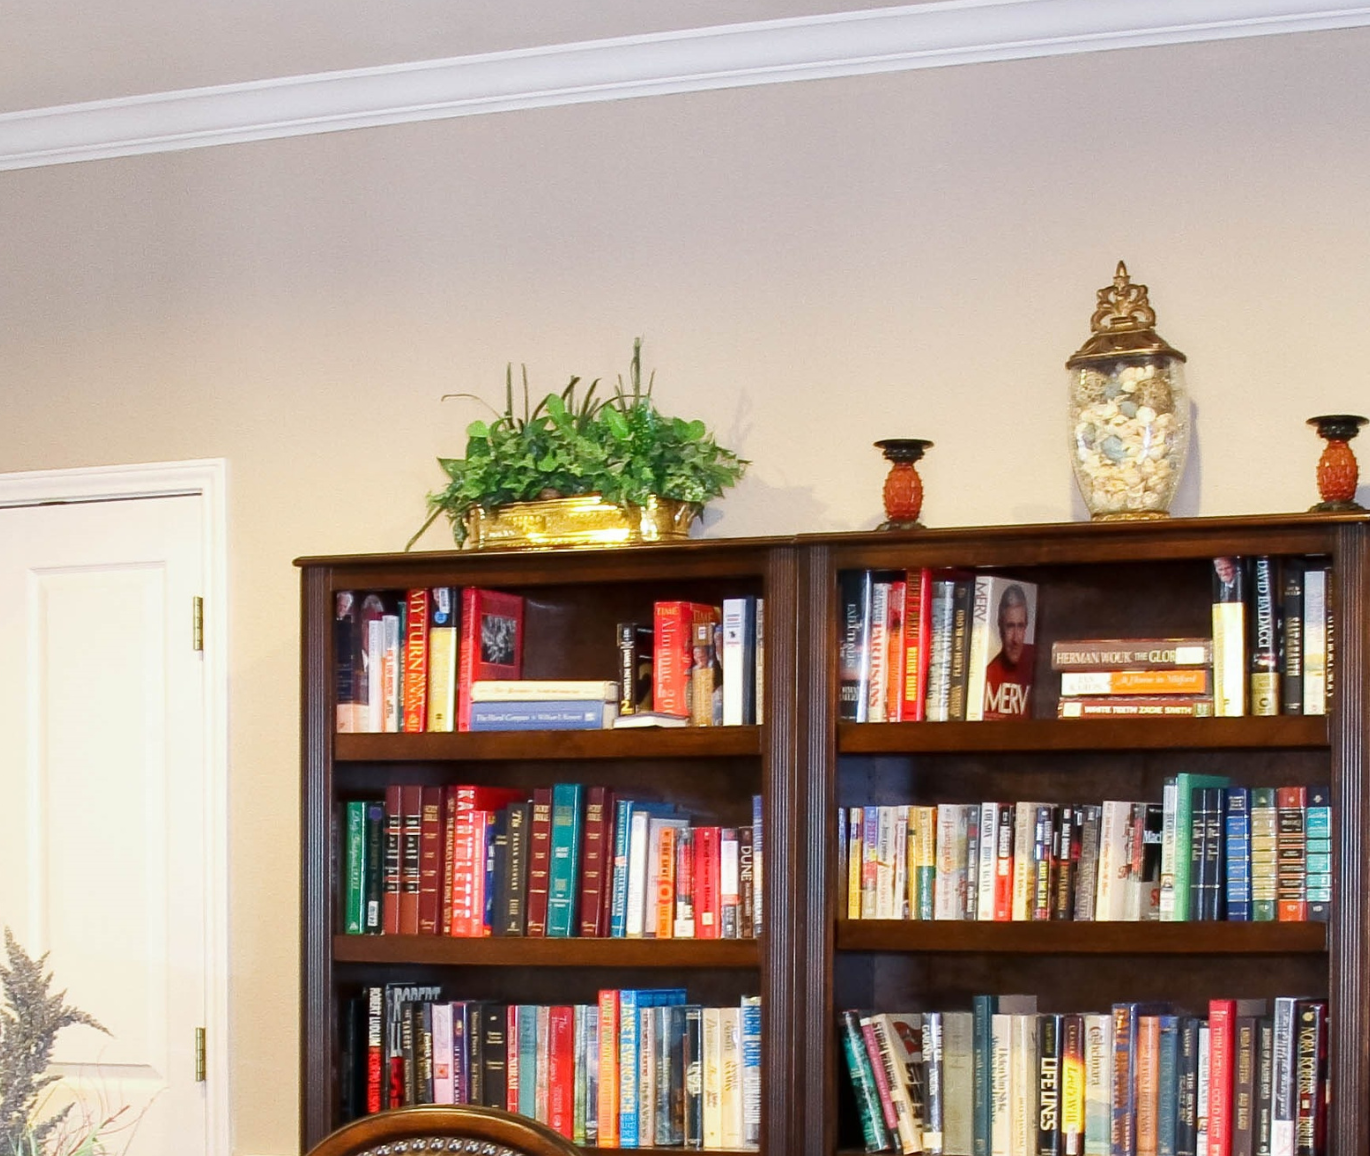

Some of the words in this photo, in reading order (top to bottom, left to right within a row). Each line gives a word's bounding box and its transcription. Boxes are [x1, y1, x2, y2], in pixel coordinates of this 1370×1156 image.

[1257, 560, 1269, 593] DAVID
[409, 590, 424, 619] MY
[975, 582, 987, 622] MERV
[1258, 596, 1270, 648] BALDACCI
[409, 621, 424, 671] TURN
[662, 618, 676, 683] Almanac
[1056, 651, 1100, 665] HERMAN
[1101, 650, 1132, 664] WOUK
[1135, 651, 1147, 661] THE
[1148, 649, 1176, 663] GLOR
[870, 624, 883, 707] PARTISANS
[985, 682, 1030, 713] MERV
[457, 789, 474, 846] KATHY
[741, 846, 752, 882] DUNE
[369, 987, 381, 1015] ROBERT
[369, 1016, 381, 1046] LUDLUM
[620, 1003, 635, 1038] JANET
[743, 1006, 760, 1035] ROBIN
[744, 1040, 760, 1067] COOK
[1088, 1026, 1104, 1086] Cashelmara
[1300, 1027, 1315, 1052] NORA
[621, 1042, 635, 1113] EVANOVICH
[1040, 1057, 1058, 1089] LIFE
[1299, 1056, 1315, 1095] ROBERTS
[1040, 1091, 1057, 1131] LINES
[1213, 1088, 1221, 1115] COLD
[1298, 1116, 1314, 1148] TRIBUTE
